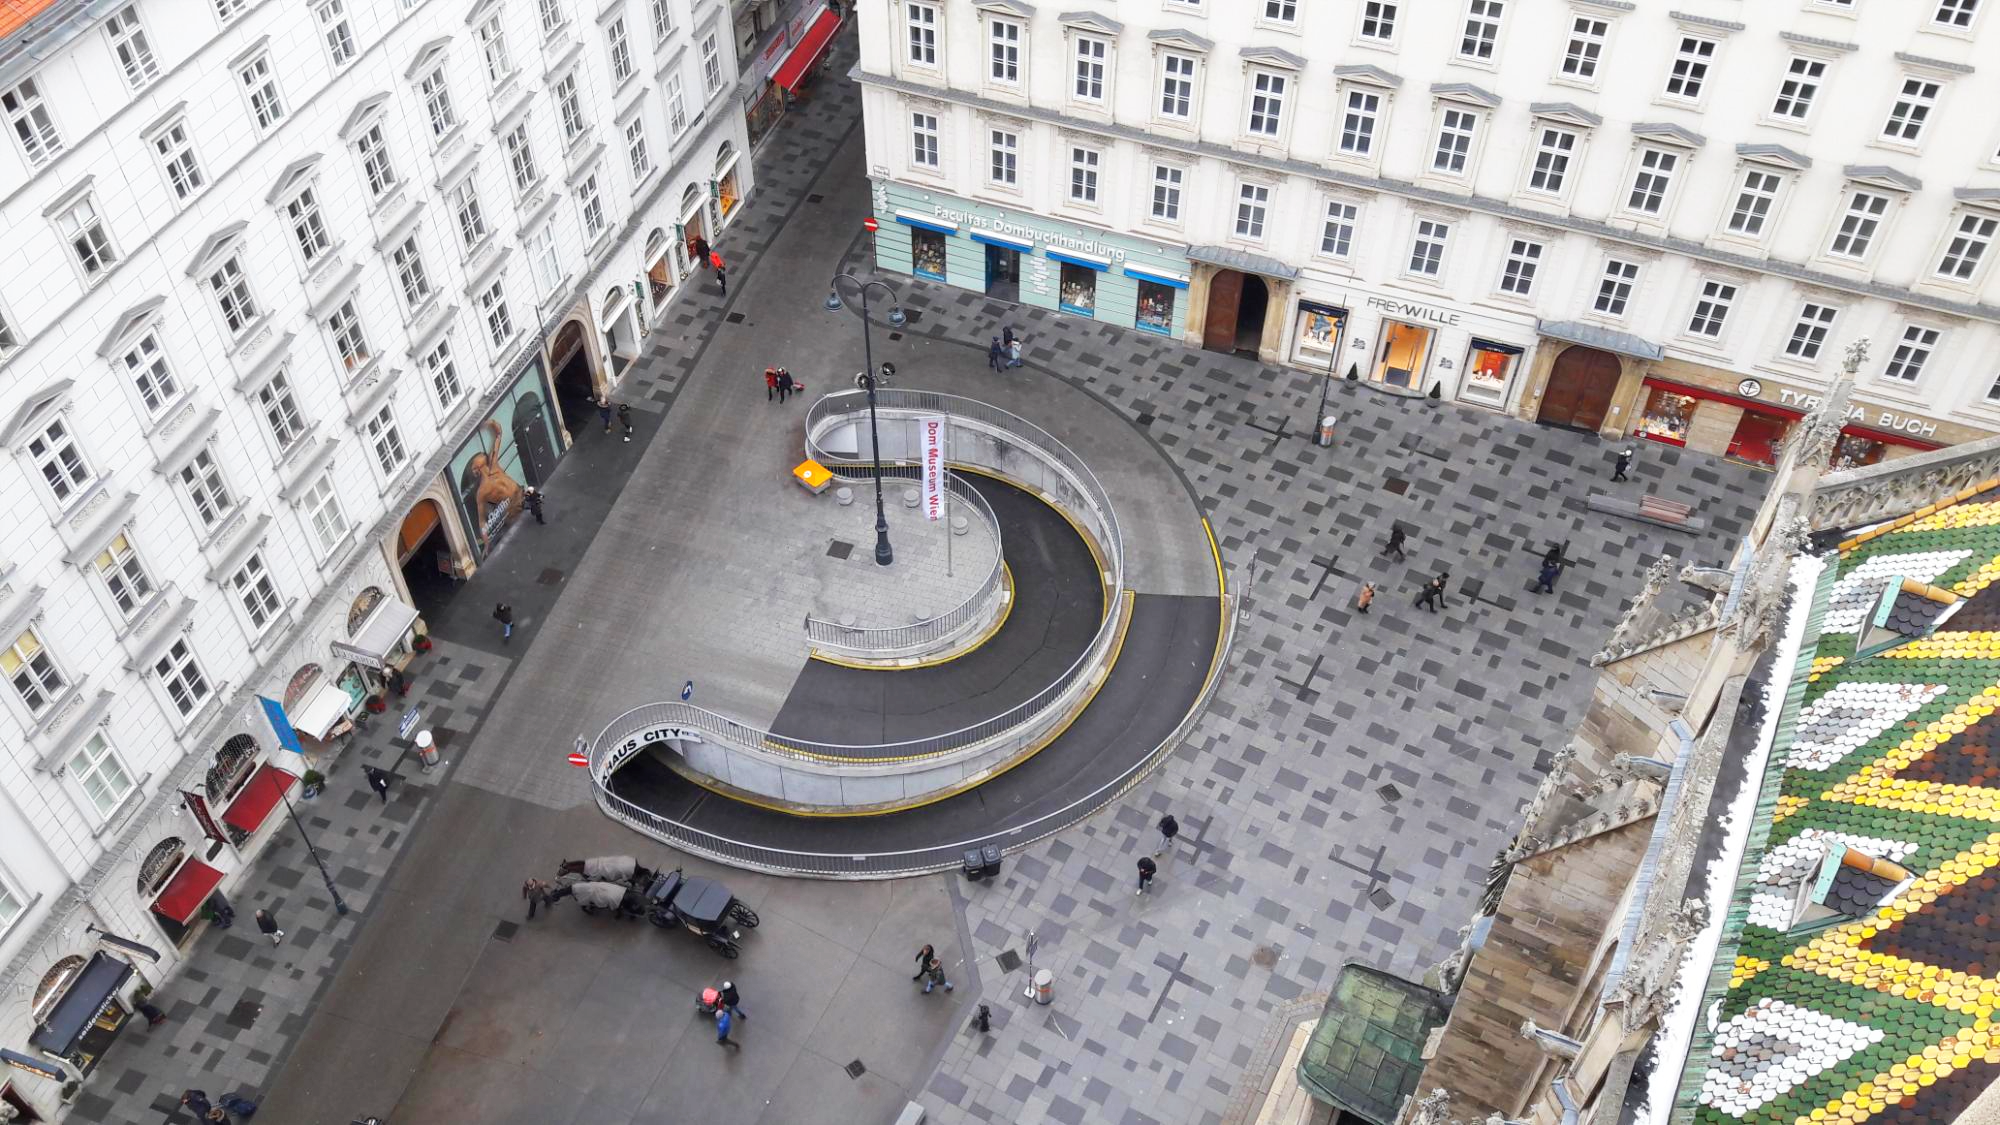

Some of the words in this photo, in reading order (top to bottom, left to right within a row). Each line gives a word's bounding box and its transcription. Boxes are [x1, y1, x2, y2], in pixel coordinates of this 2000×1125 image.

[934, 205, 988, 228] Facultas
[993, 219, 1126, 262] Dombuchhandlung
[1367, 296, 1461, 327] FREYWILLE
[1780, 389, 1865, 422] TYRIA
[1878, 413, 1937, 437] BUCH
[928, 421, 938, 445] Dom
[928, 447, 939, 492] Museum
[929, 494, 940, 522] Wien
[643, 728, 681, 742] CITY
[78, 985, 119, 1041] seidensticker
